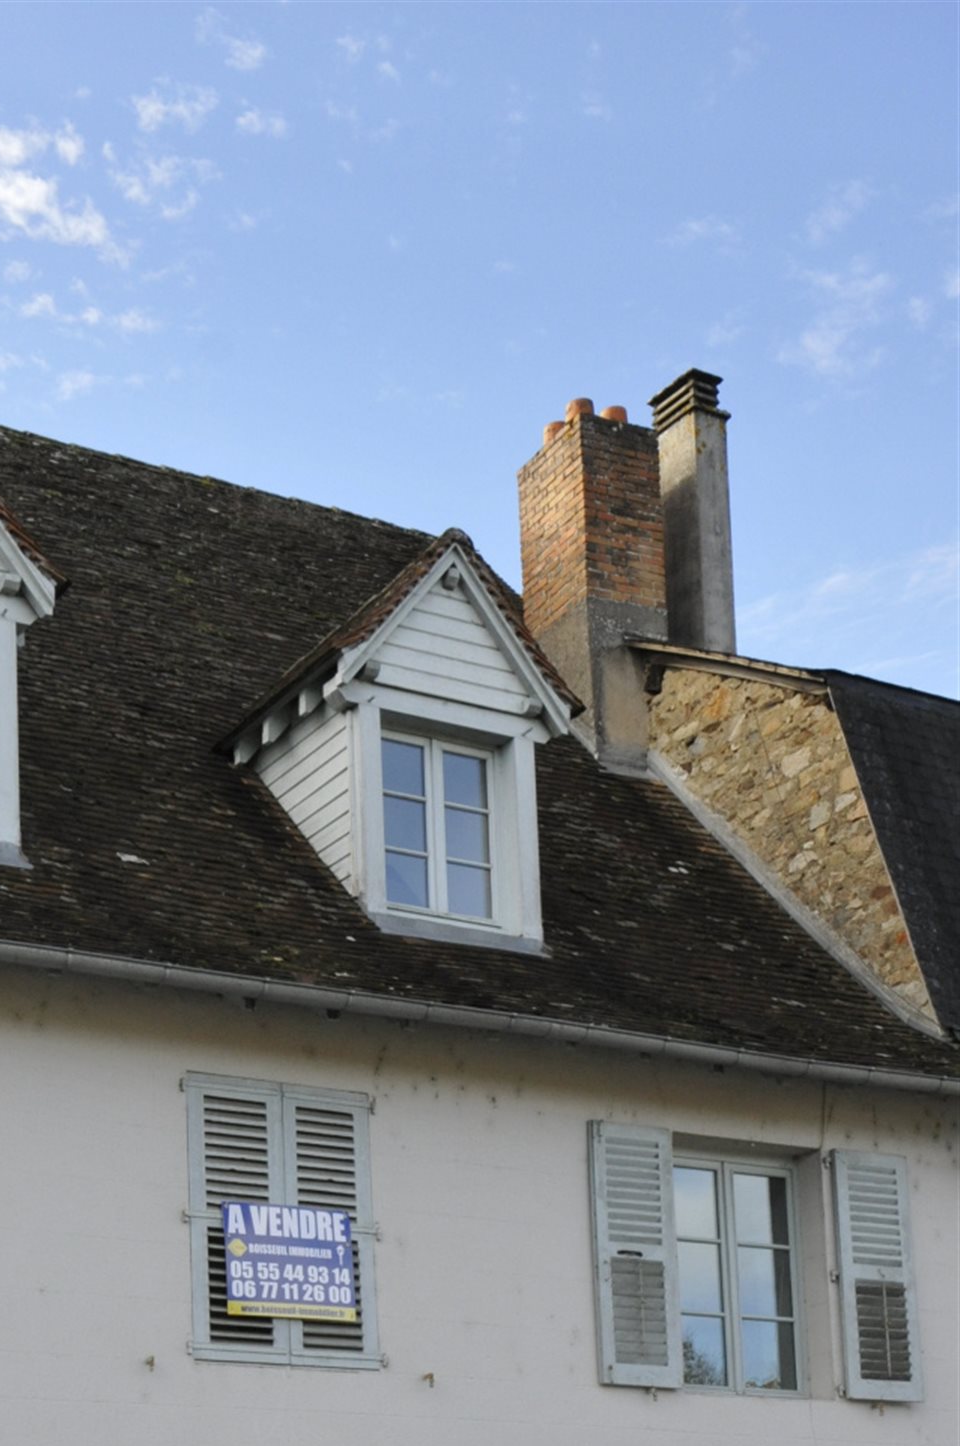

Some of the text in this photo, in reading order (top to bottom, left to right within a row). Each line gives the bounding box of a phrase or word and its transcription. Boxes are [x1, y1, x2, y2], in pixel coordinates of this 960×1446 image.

[228, 1204, 347, 1242] A VENDRE
[230, 1260, 351, 1286] 05 55 44 93 14
[231, 1280, 351, 1304] 06 77 11 26 00
